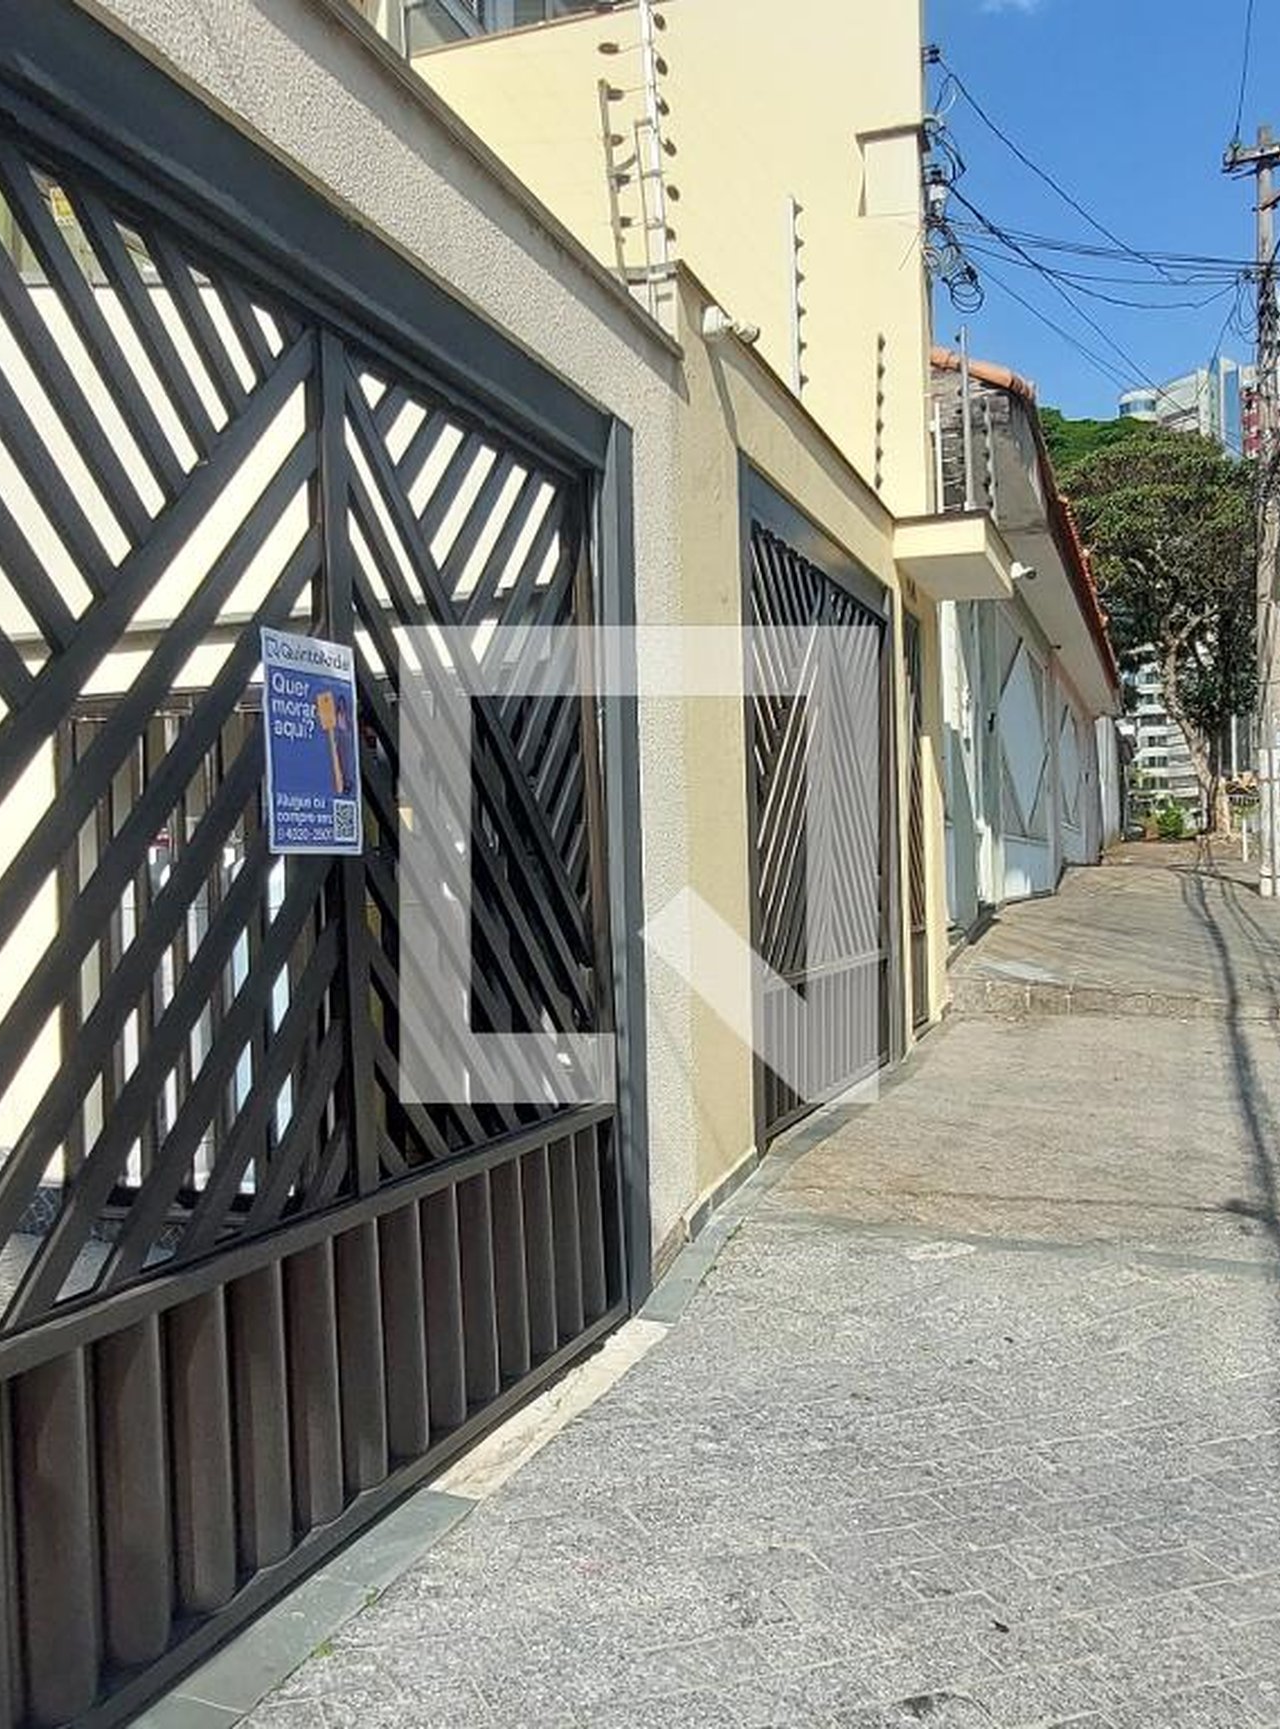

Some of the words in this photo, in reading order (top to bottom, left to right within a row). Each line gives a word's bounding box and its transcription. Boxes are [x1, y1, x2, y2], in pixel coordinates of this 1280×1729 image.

[272, 672, 310, 698] Quer
[271, 699, 316, 718] morar
[274, 717, 314, 742] aqui?
